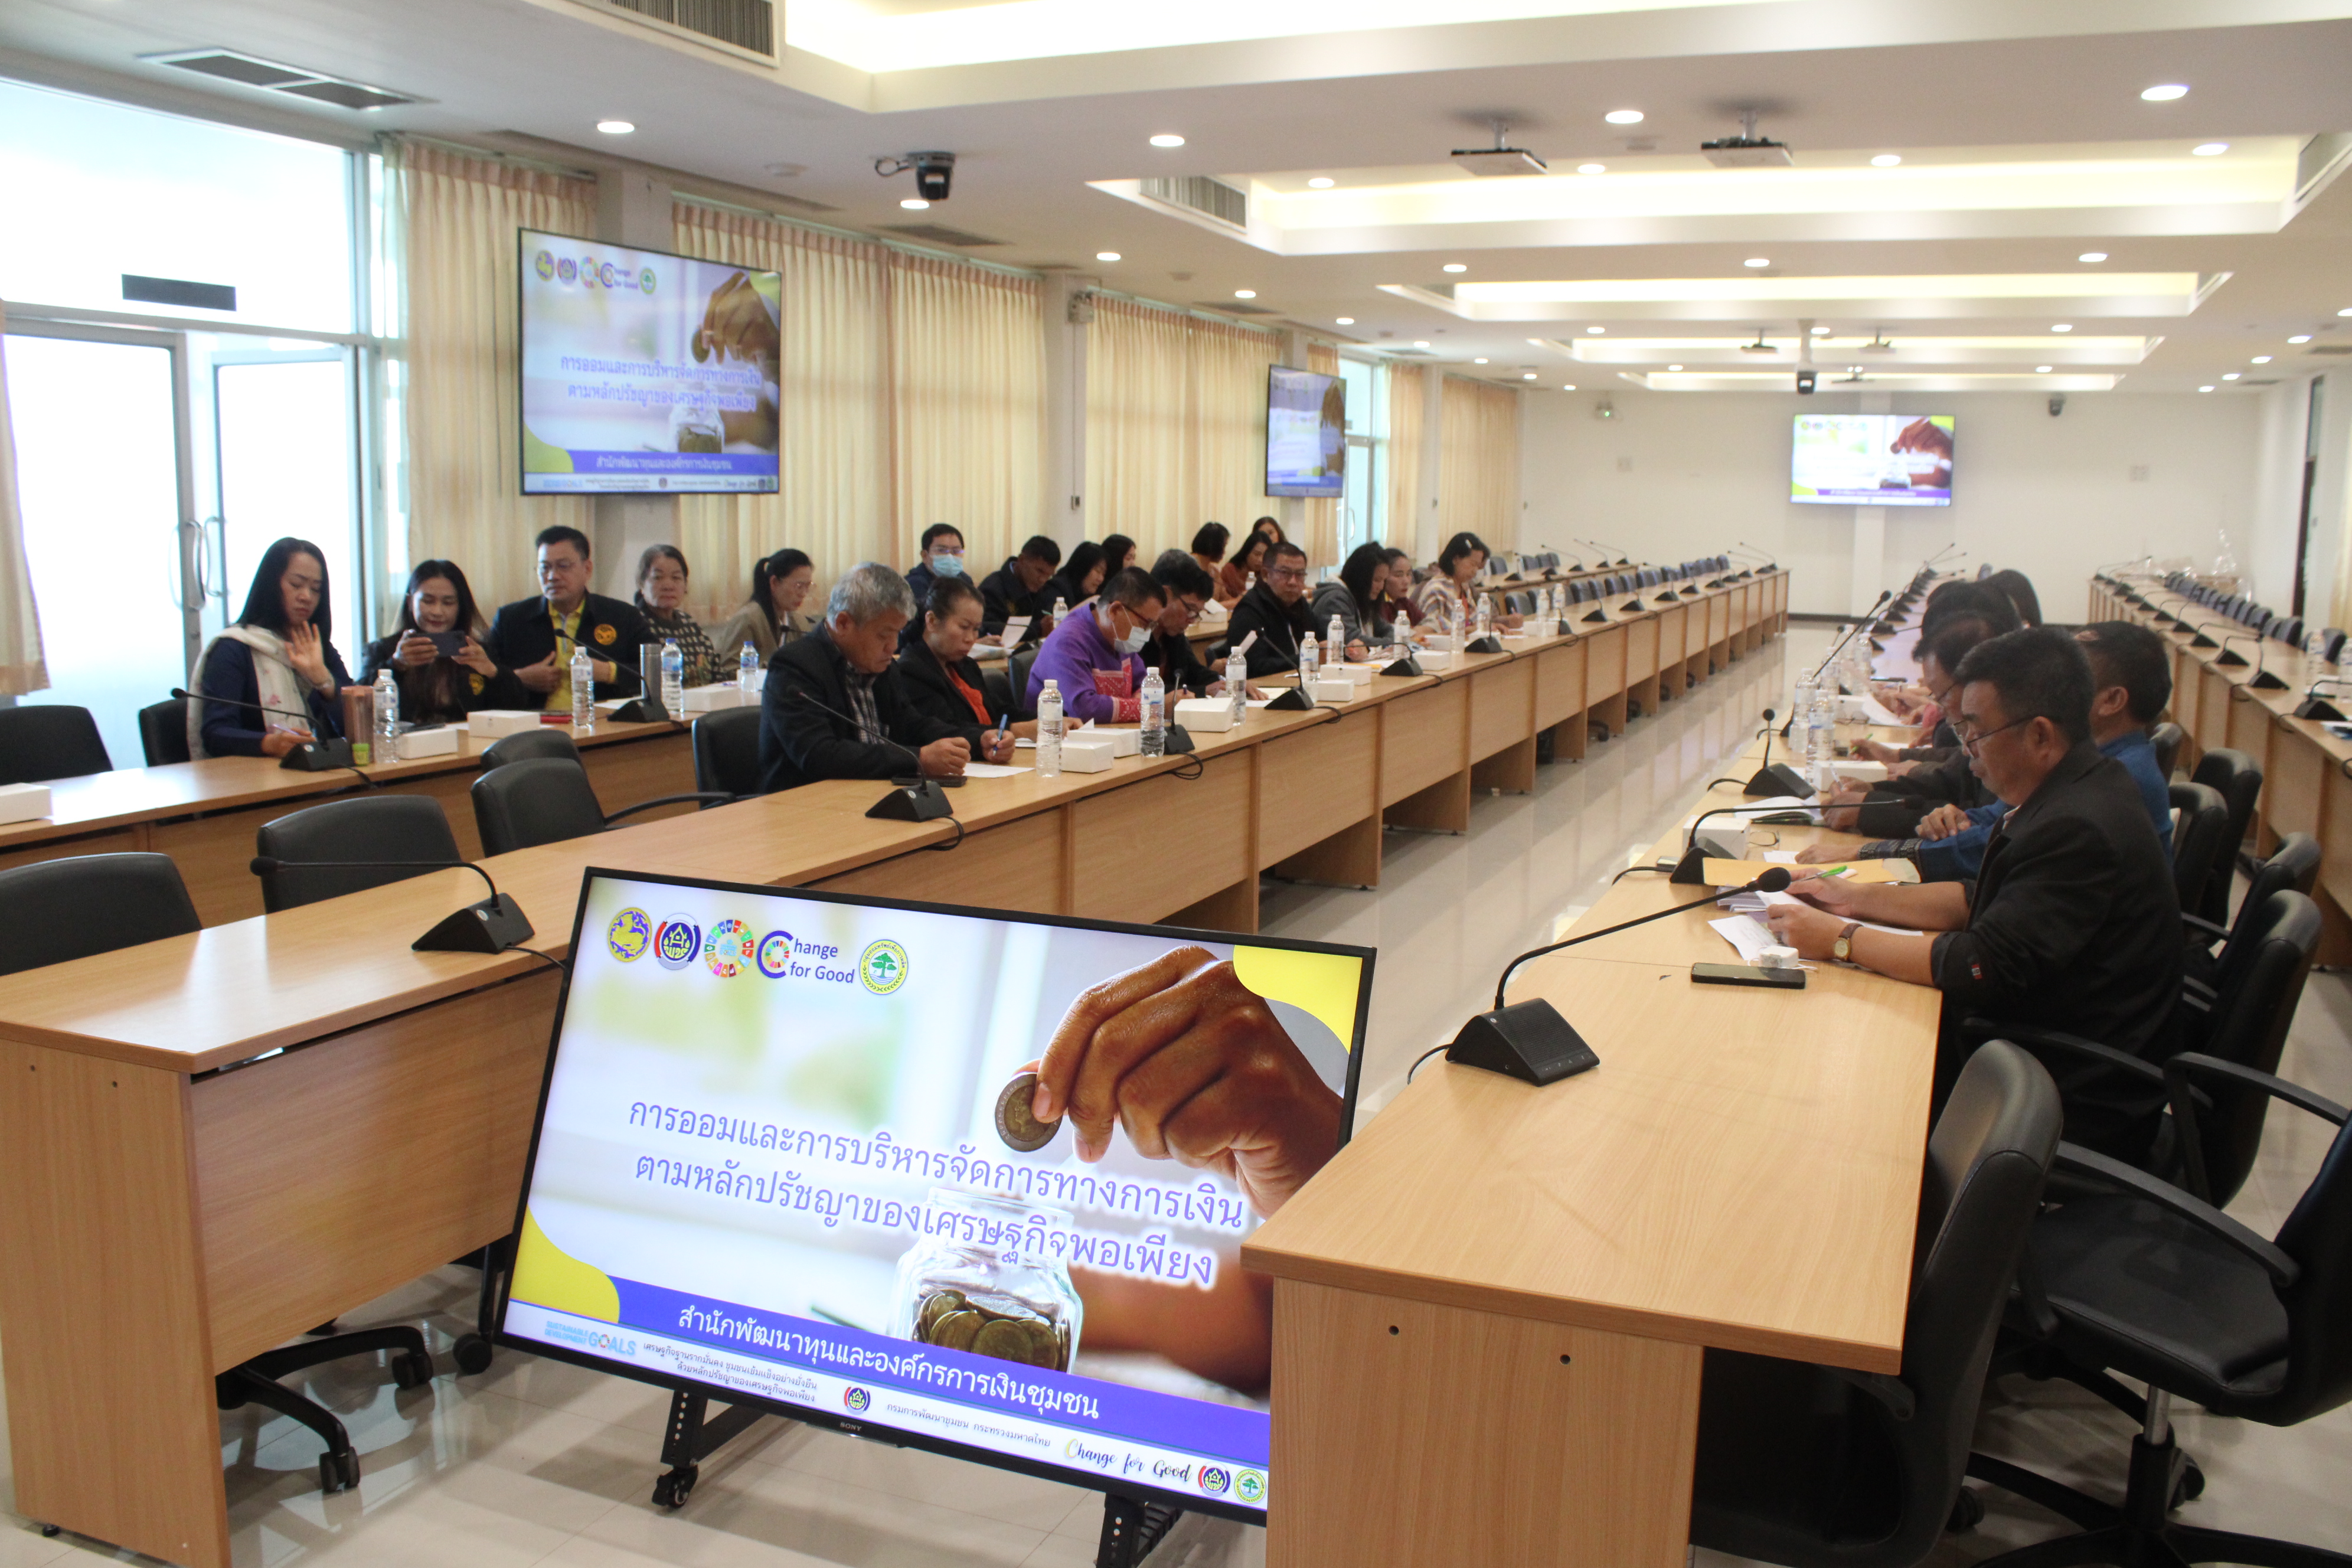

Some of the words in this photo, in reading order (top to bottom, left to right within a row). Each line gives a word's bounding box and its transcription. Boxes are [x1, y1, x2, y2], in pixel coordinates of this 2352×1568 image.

[790, 962, 811, 978] for
[815, 966, 855, 984] Good
[629, 1102, 1243, 1229] การออมและการบริหารจัดการทางการเงิน
[636, 1155, 1212, 1284] ตามหลักปรัชญาของเศรษฐกิจพอเพียง
[588, 1331, 636, 1356] GOALS
[678, 1305, 1100, 1419] สำนักพัฒนาทุนและองค์กรการเงินชุมชน
[840, 1422, 862, 1431] SONY
[973, 1423, 1051, 1448] กระทรวงมหาดไทย
[1066, 1438, 1118, 1468] Change
[1123, 1453, 1146, 1474] for
[1153, 1460, 1194, 1482] Good
